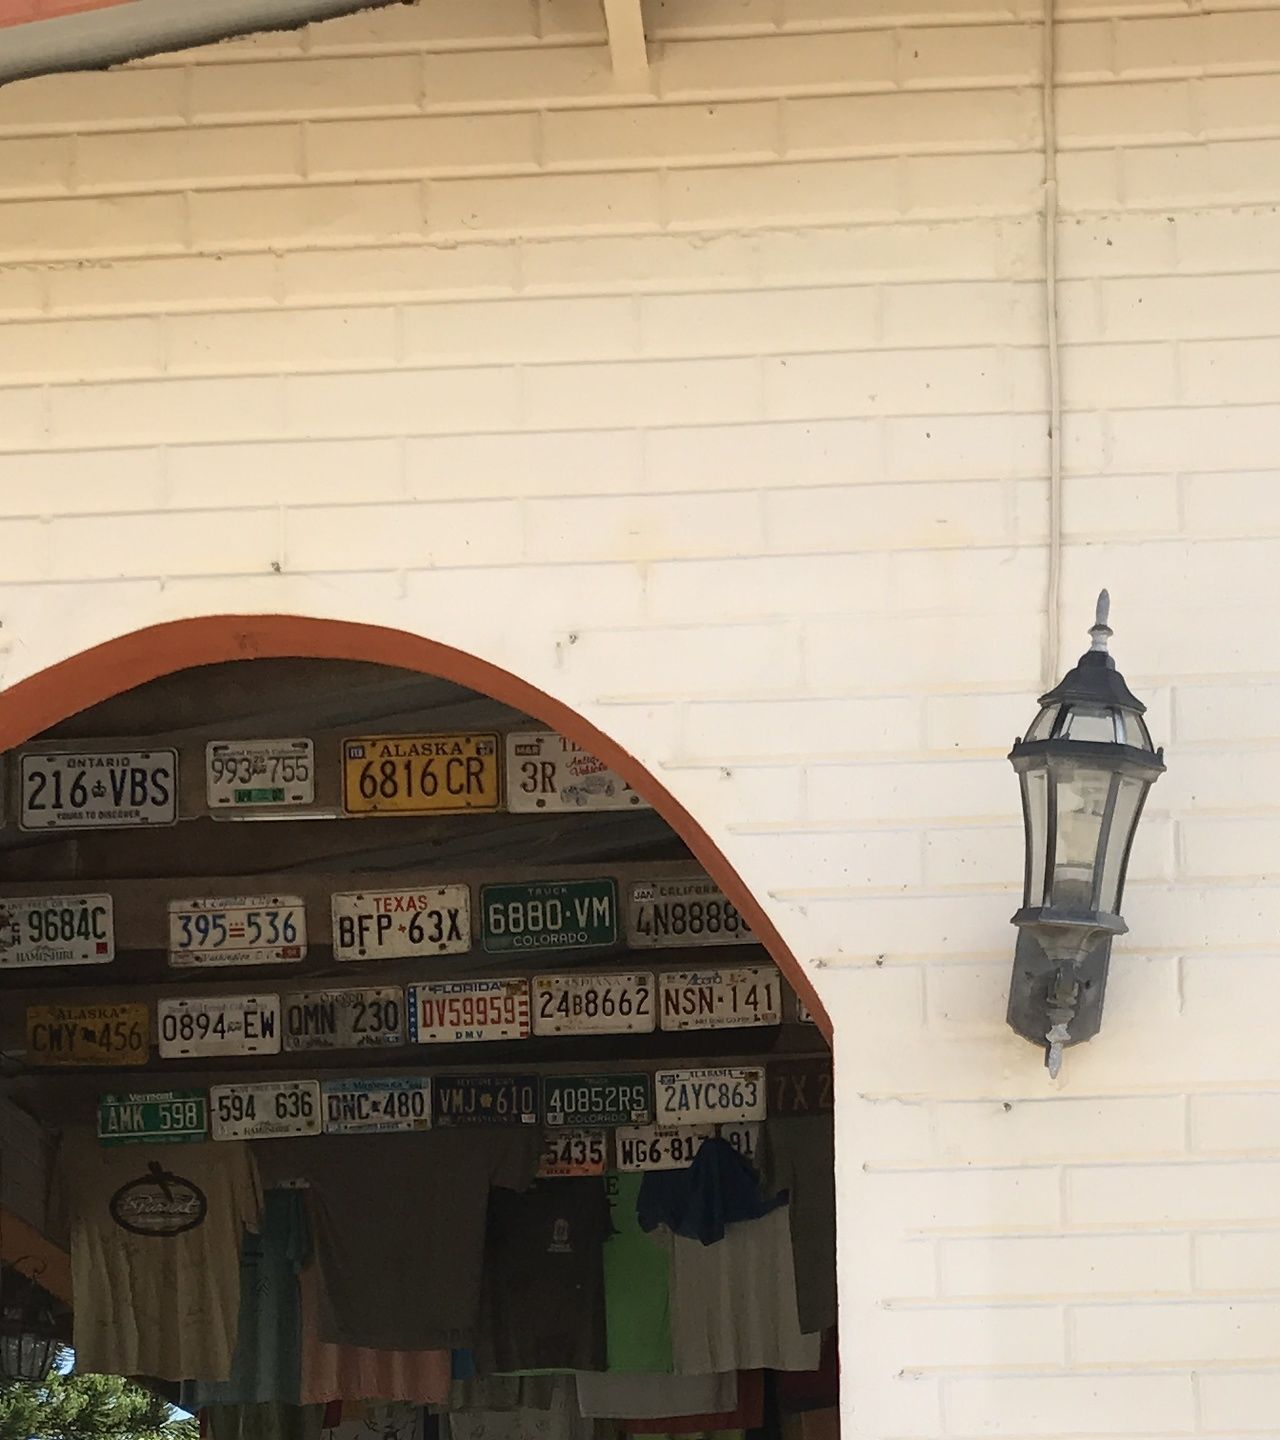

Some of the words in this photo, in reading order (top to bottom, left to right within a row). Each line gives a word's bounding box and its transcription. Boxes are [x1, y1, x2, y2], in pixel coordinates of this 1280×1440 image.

[67, 757, 130, 768] ONTARIO
[380, 742, 462, 757] ALASKA
[28, 770, 88, 810] 216
[110, 768, 169, 807] VBS
[521, 761, 557, 793] 3R
[373, 896, 427, 913] TEXAS
[527, 888, 568, 896] TRUCK
[28, 907, 106, 942] 9684C
[178, 914, 226, 948] 395
[247, 912, 296, 944] 536
[339, 915, 392, 948] BFP
[408, 909, 461, 943] 63X
[637, 902, 751, 936] 4N8888
[513, 932, 588, 946] COLORADO
[434, 982, 501, 994] FLORIDA
[244, 1011, 274, 1038] EW
[352, 1001, 398, 1032] 230
[99, 1022, 142, 1051] 456
[219, 1095, 256, 1122] 594
[276, 1092, 313, 1119] 636
[384, 1092, 424, 1119] 480
[665, 1082, 757, 1112] 2AYC863
[160, 1103, 197, 1129] 598
